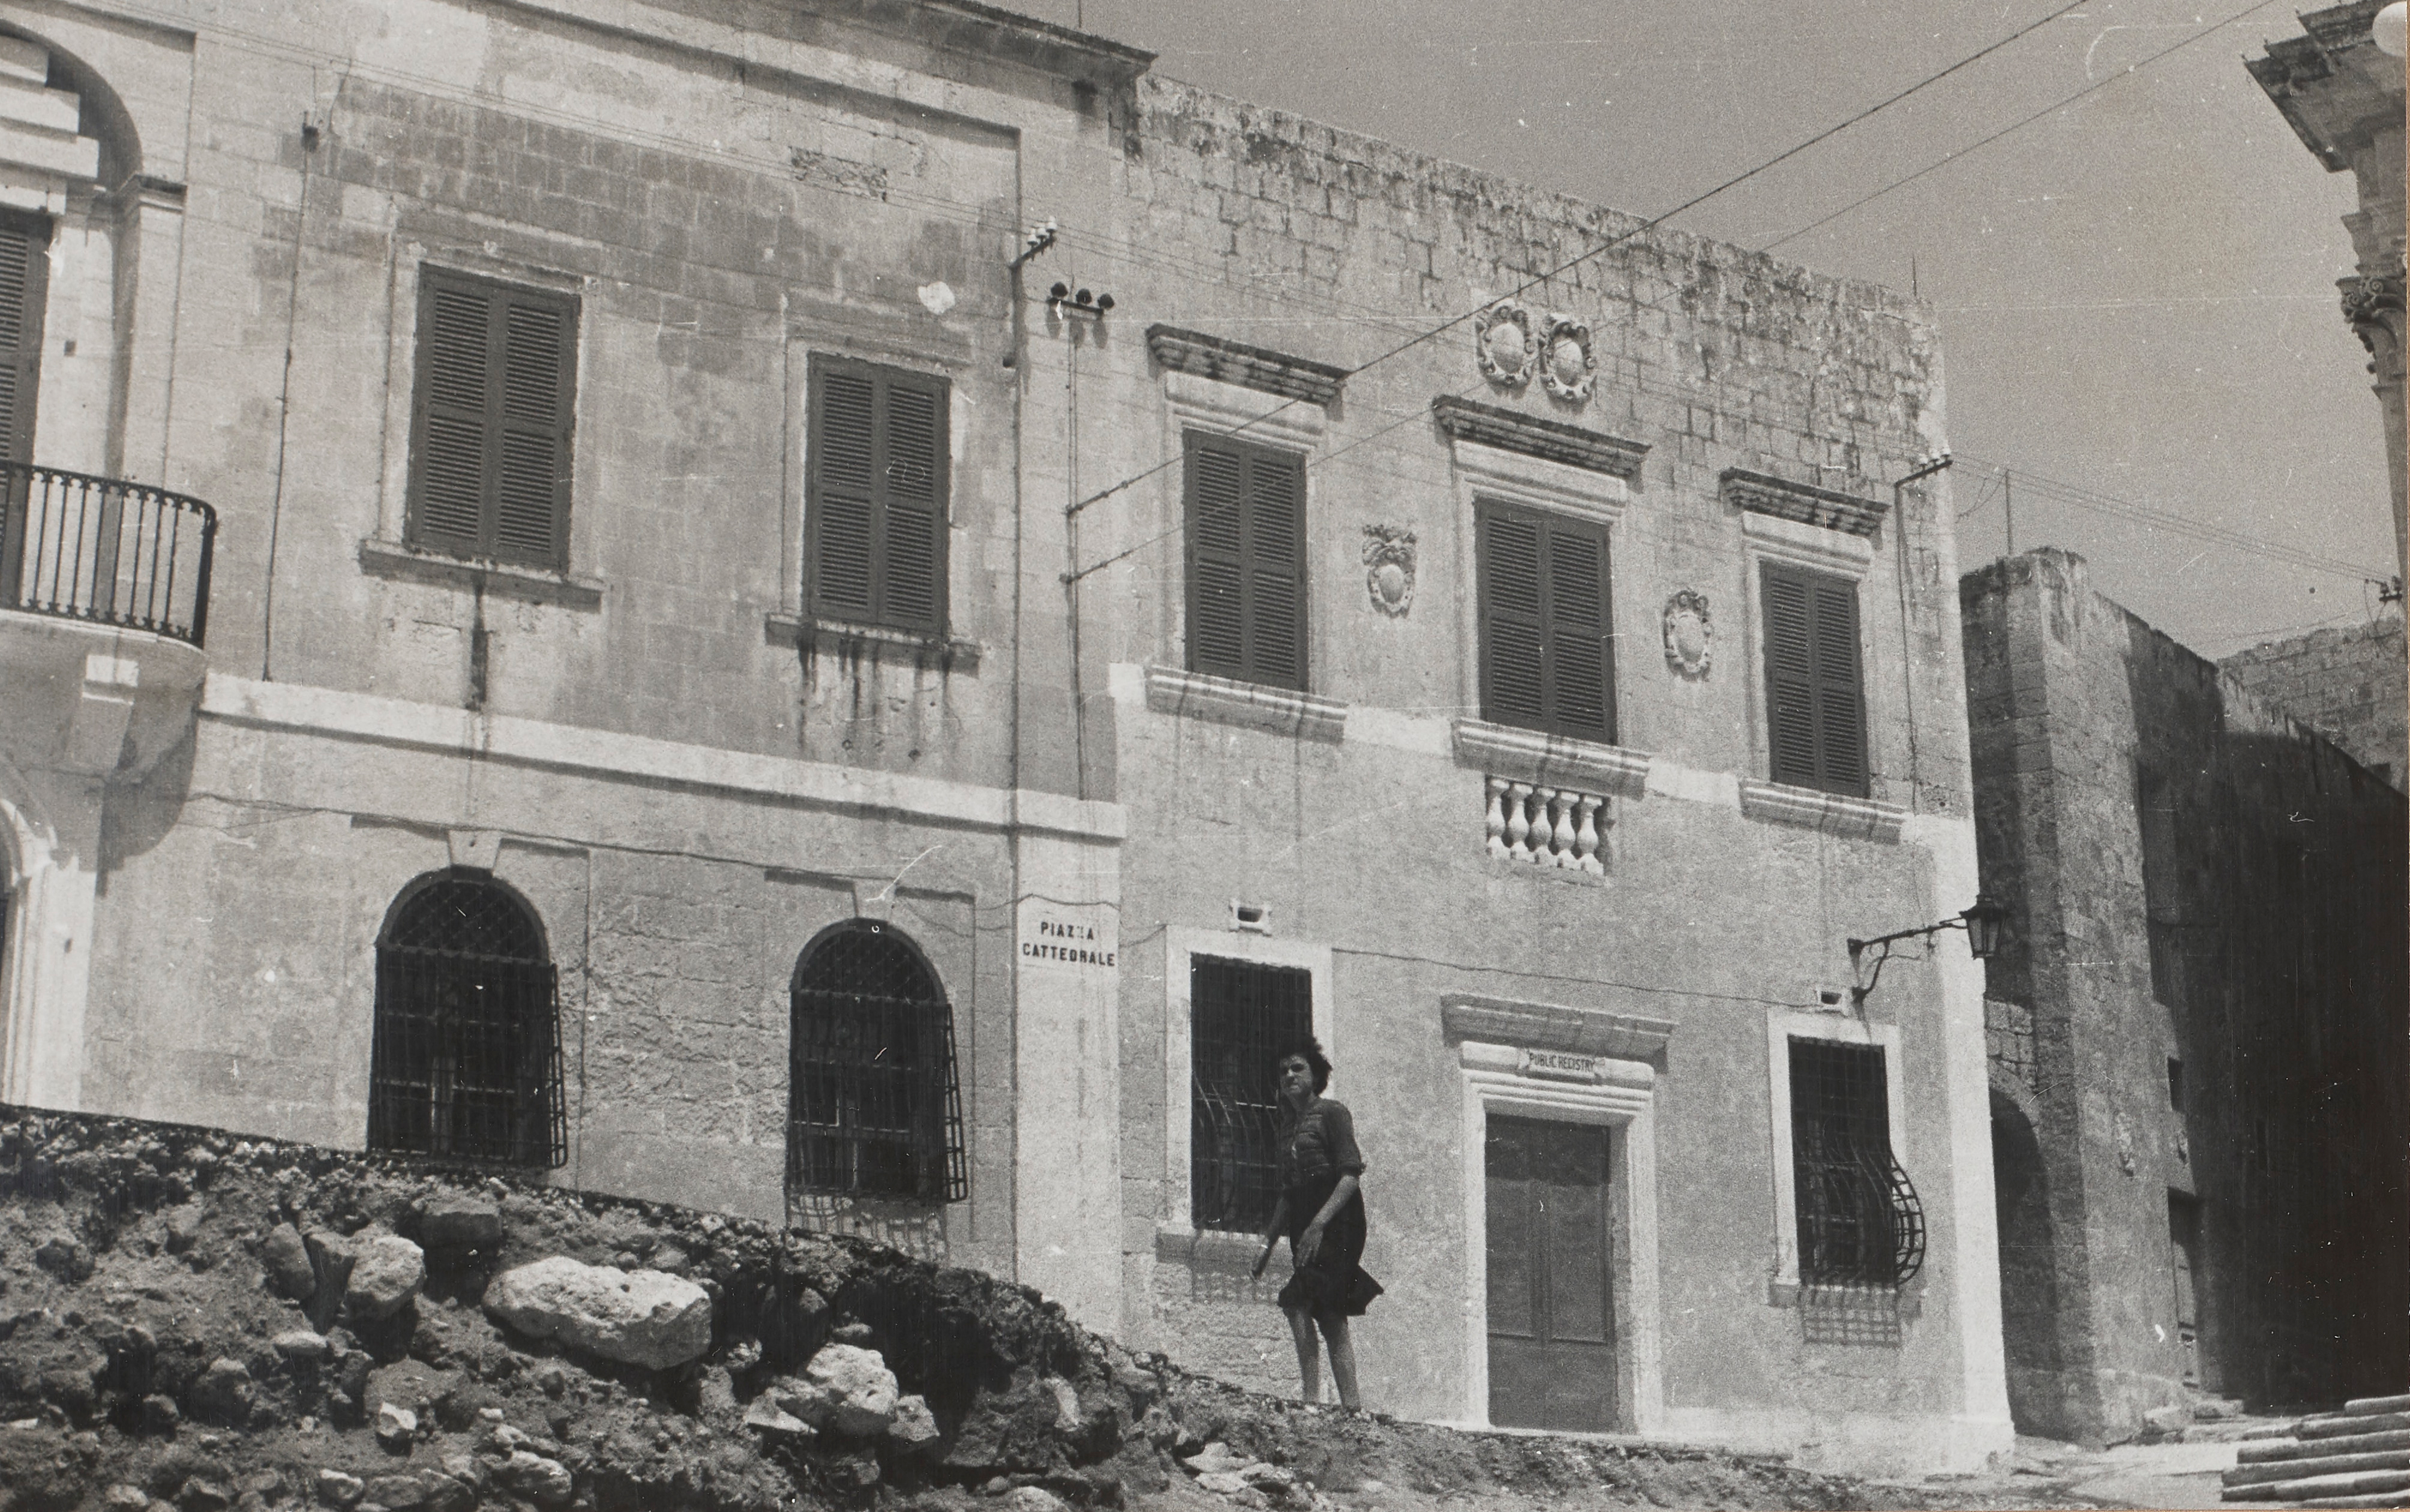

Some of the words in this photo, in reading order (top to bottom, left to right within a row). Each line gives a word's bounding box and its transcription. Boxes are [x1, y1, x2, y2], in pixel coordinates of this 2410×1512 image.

[1023, 943, 1115, 966] CATTEDRALE
[1529, 1052, 1557, 1068] PUBLIC
[1558, 1056, 1595, 1073] REGISTRY
